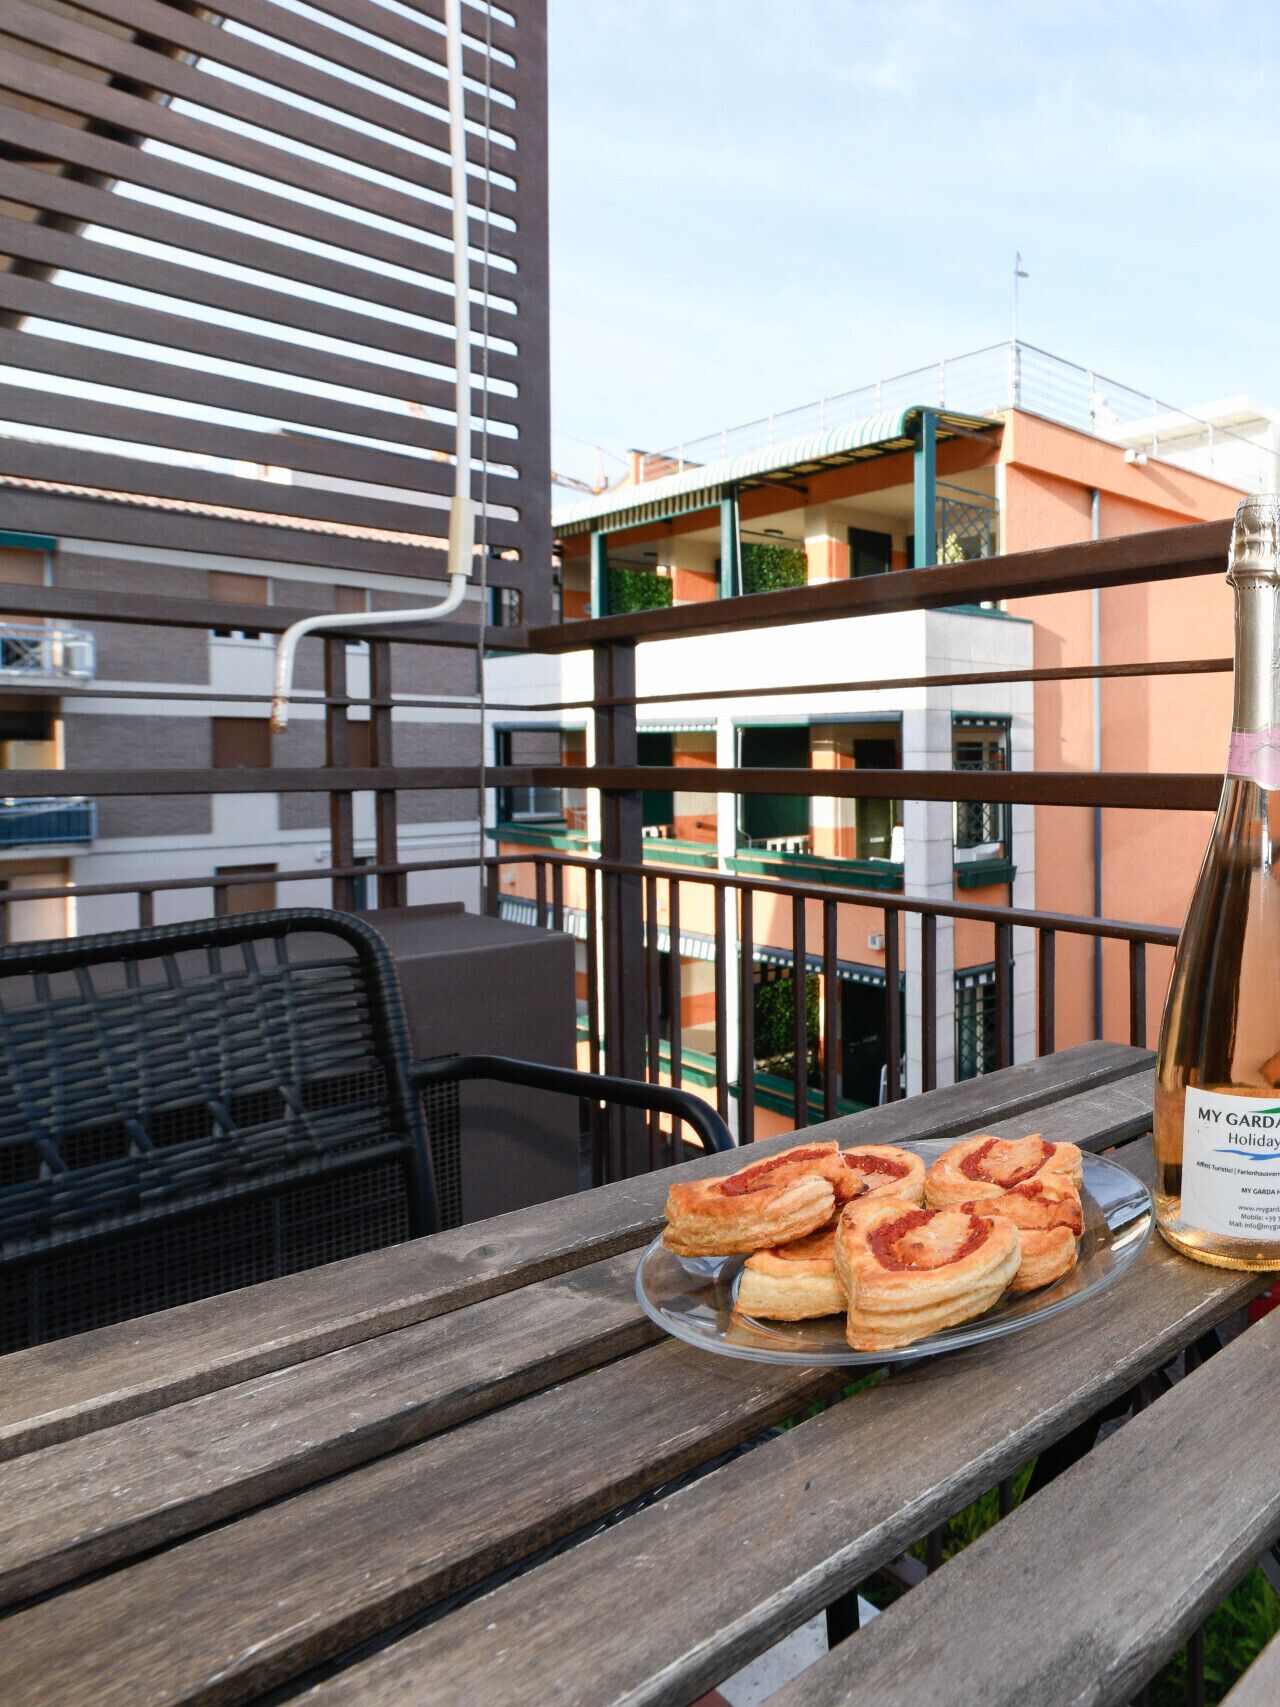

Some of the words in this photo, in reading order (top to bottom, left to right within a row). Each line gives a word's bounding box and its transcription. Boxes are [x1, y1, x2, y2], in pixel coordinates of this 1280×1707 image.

[1198, 1106, 1221, 1123] MY
[1212, 1164, 1233, 1174] Turistici
[1240, 1213, 1264, 1221] Mobile:
